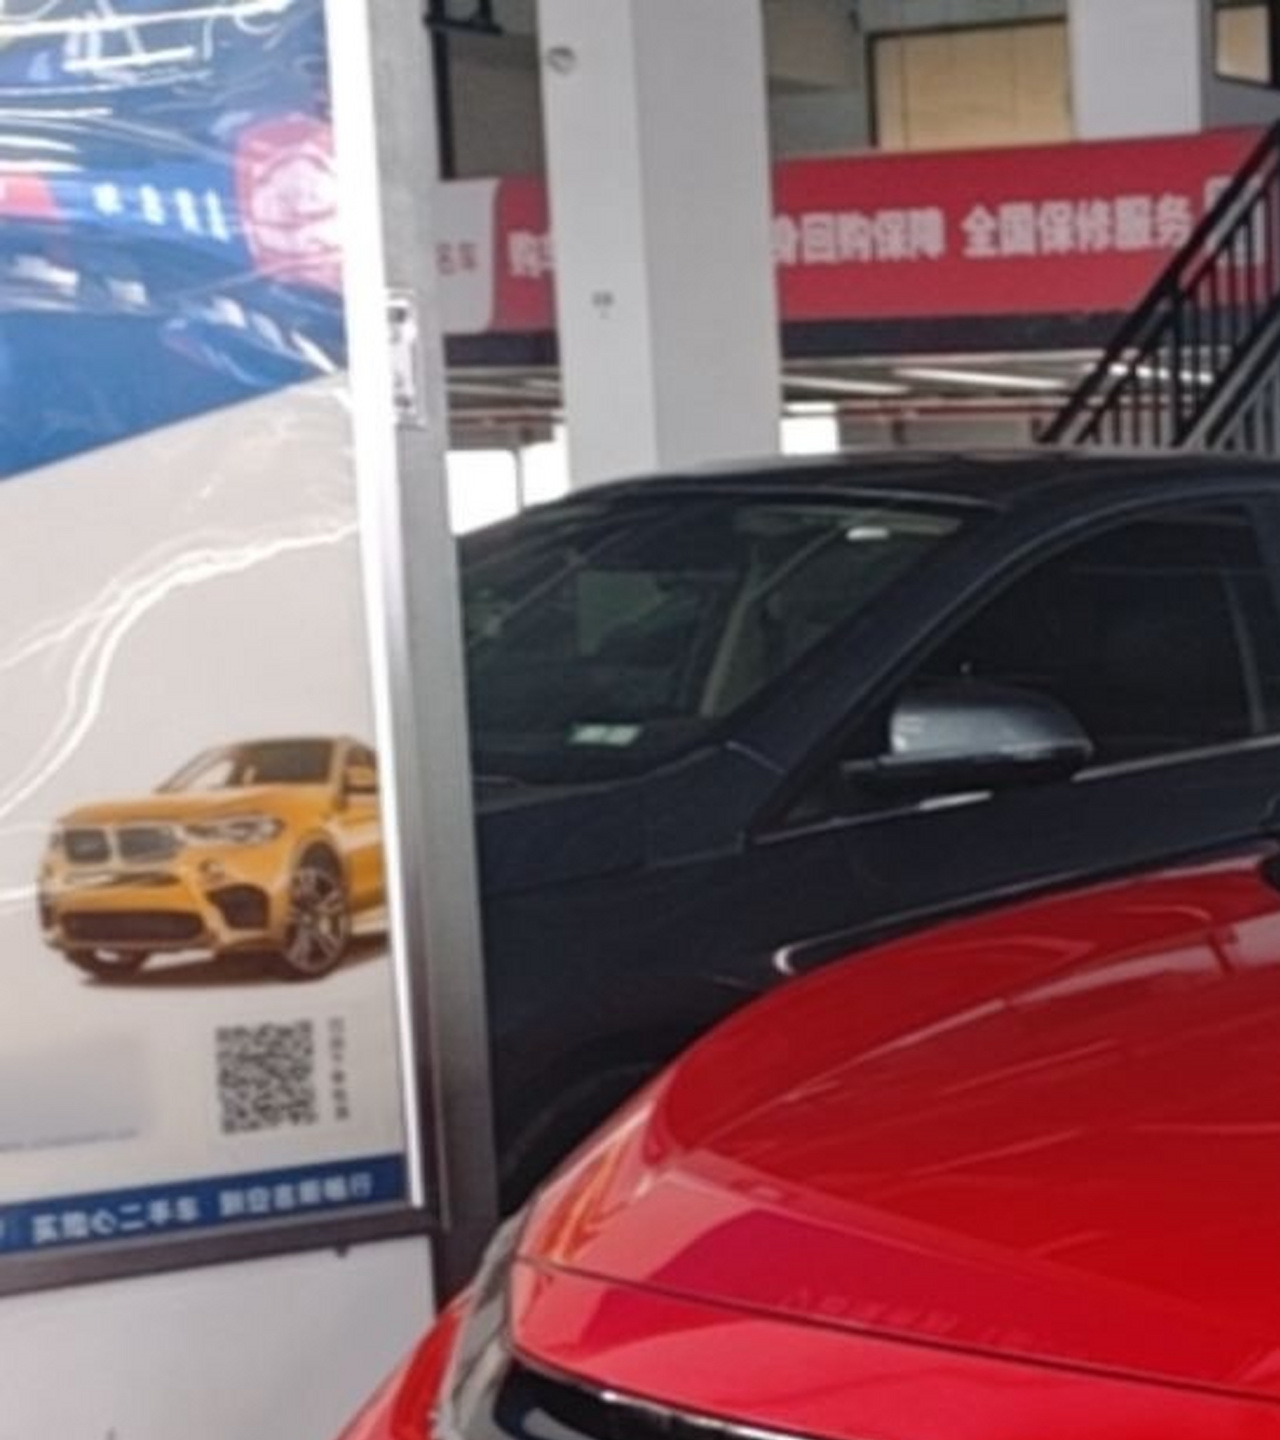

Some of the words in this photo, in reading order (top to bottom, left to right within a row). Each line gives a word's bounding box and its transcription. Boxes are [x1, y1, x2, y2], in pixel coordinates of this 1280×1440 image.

[961, 194, 1195, 257] 全国保修服务
